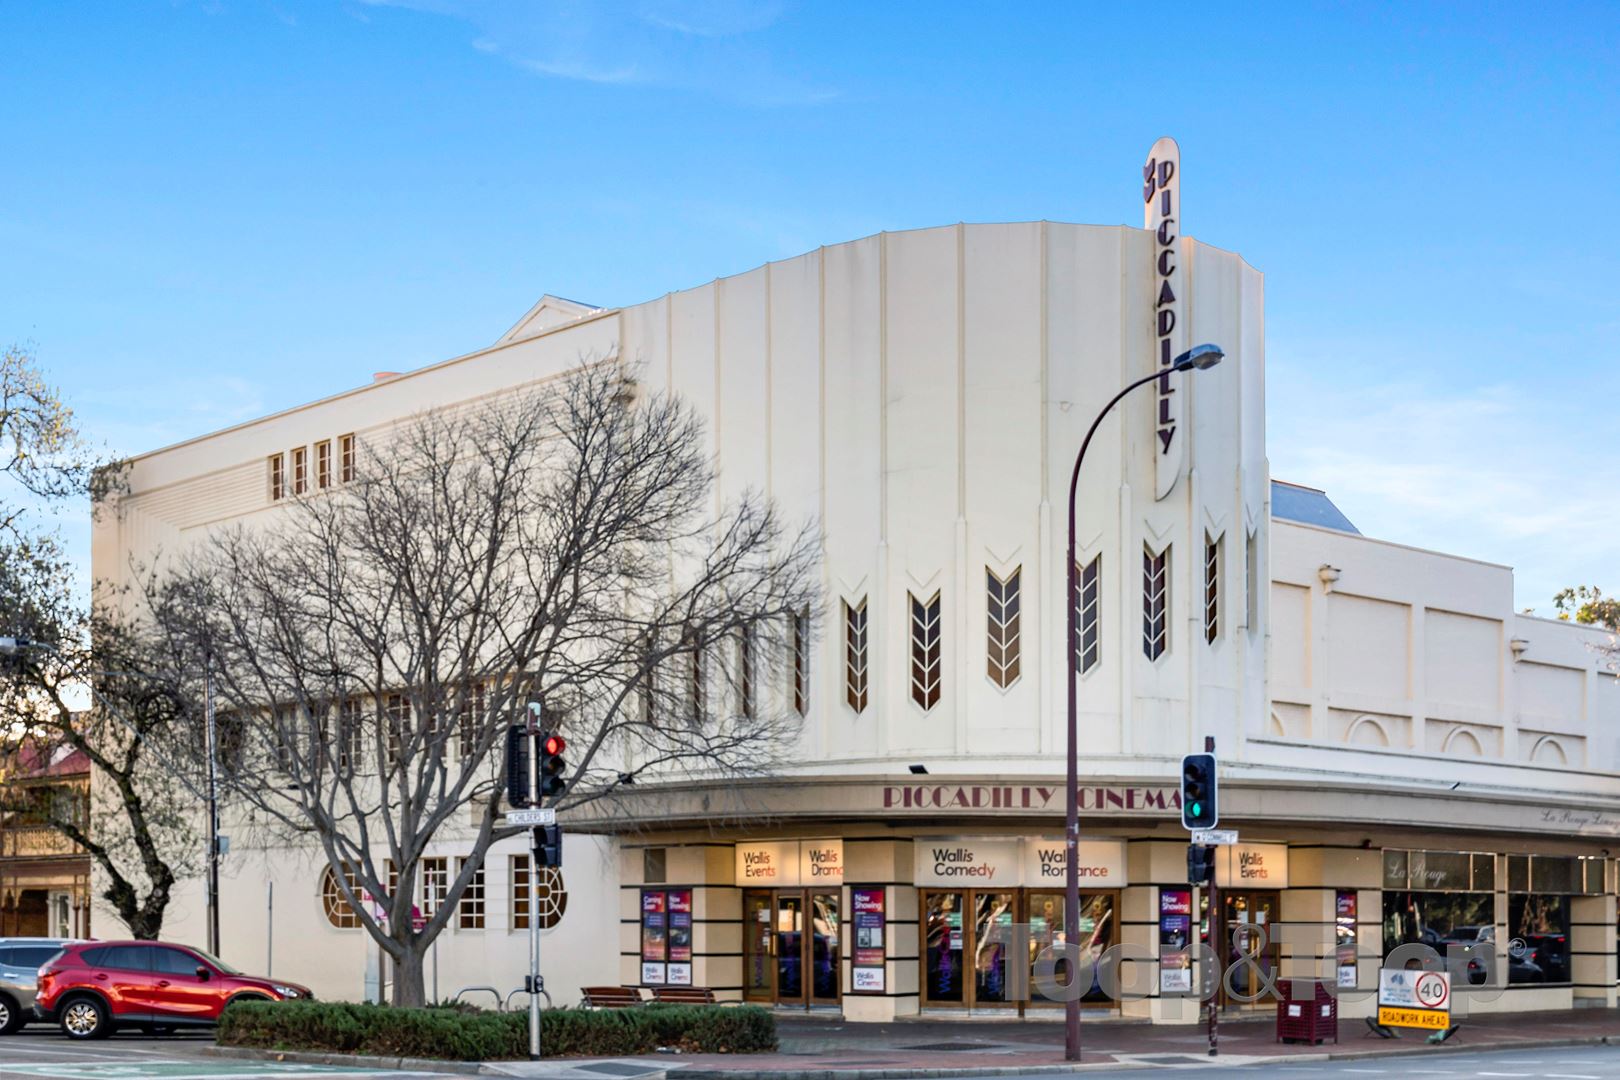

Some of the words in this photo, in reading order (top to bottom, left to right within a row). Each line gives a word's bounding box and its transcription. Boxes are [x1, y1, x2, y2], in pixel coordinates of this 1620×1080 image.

[1156, 159, 1177, 455] PICCADILLY
[883, 786, 1056, 809] PICCADILLY
[743, 851, 771, 864] Wallis
[809, 849, 838, 863] Wallis
[932, 848, 974, 863] Wallis
[1238, 851, 1263, 865] Wallis
[745, 865, 776, 877] Events
[933, 862, 996, 880] Comedy
[1240, 865, 1268, 879] Events
[1386, 861, 1406, 879] La
[1409, 862, 1448, 887] Rouge
[854, 893, 871, 902] Now
[1162, 894, 1177, 903] Now
[854, 901, 882, 911] Showing
[1161, 902, 1188, 912] Showing
[1420, 982, 1443, 998] 40
[1382, 1011, 1420, 1024] ROADWORK
[1421, 1014, 1447, 1026] AHEAD
